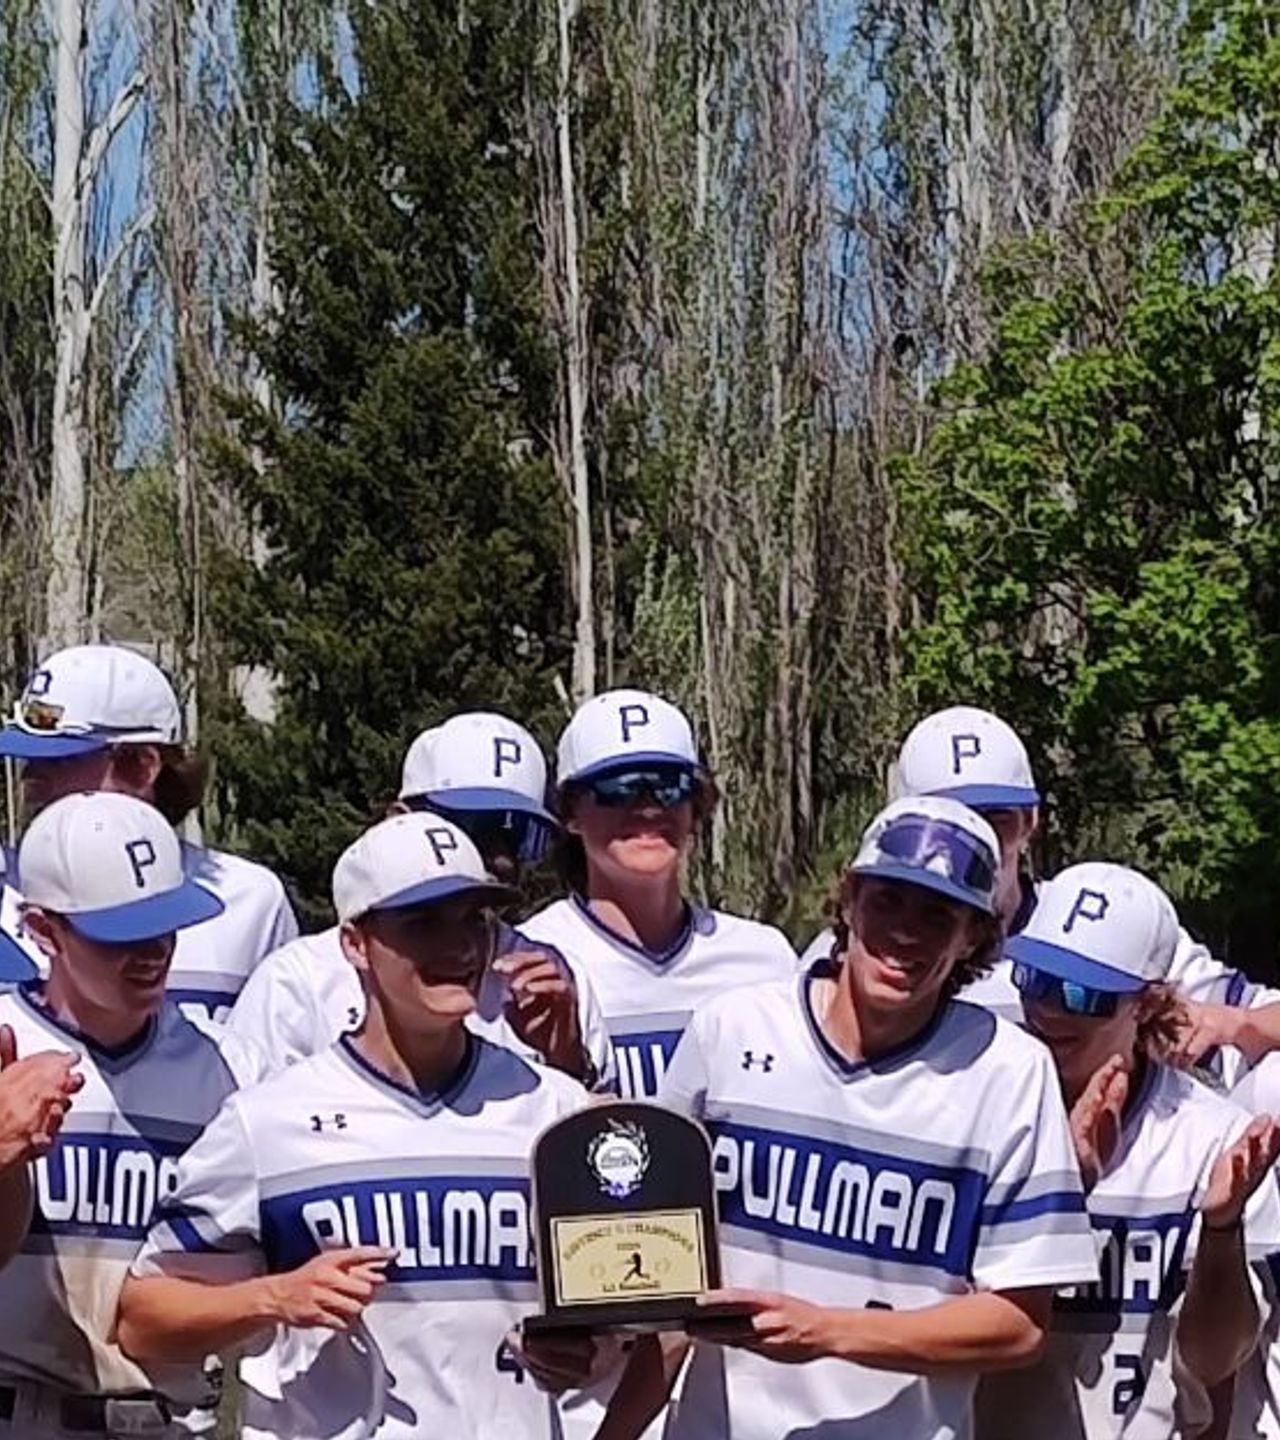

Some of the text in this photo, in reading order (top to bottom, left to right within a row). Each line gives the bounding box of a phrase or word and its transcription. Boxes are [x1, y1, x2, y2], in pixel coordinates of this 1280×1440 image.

[619, 704, 650, 742] P
[493, 738, 522, 778] P
[951, 735, 981, 774] P
[124, 839, 157, 888] P
[424, 826, 458, 867] P
[1062, 886, 1111, 934] P
[27, 1145, 181, 1227] ULLMA
[712, 1135, 956, 1255] PULLMAN
[302, 1190, 536, 1269] PULLMA
